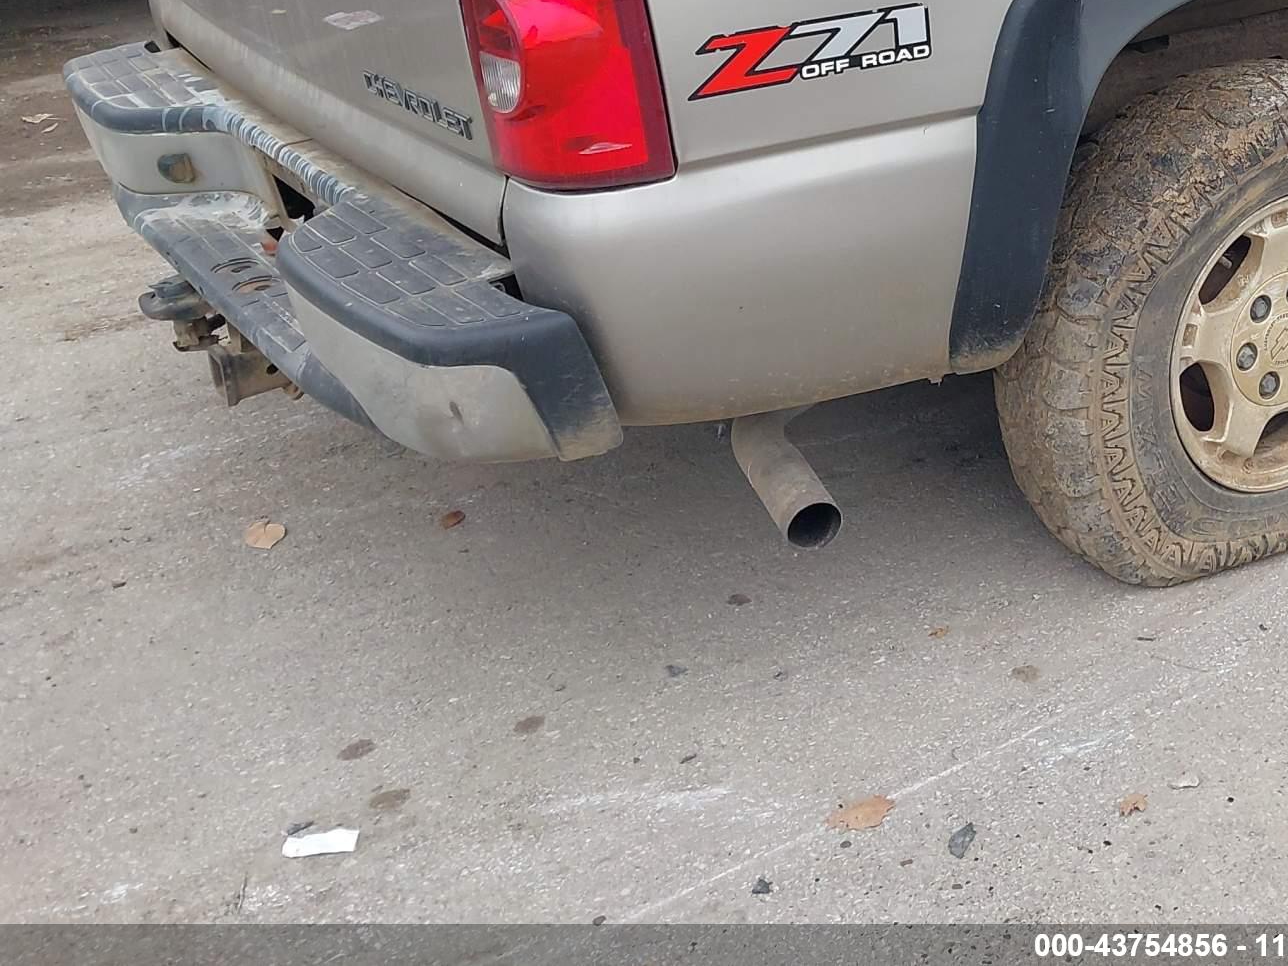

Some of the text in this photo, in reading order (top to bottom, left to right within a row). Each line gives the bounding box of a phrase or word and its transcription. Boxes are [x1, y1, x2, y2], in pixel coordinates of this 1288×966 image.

[688, 2, 931, 101] Z71
[801, 44, 931, 79] OFF ROAD
